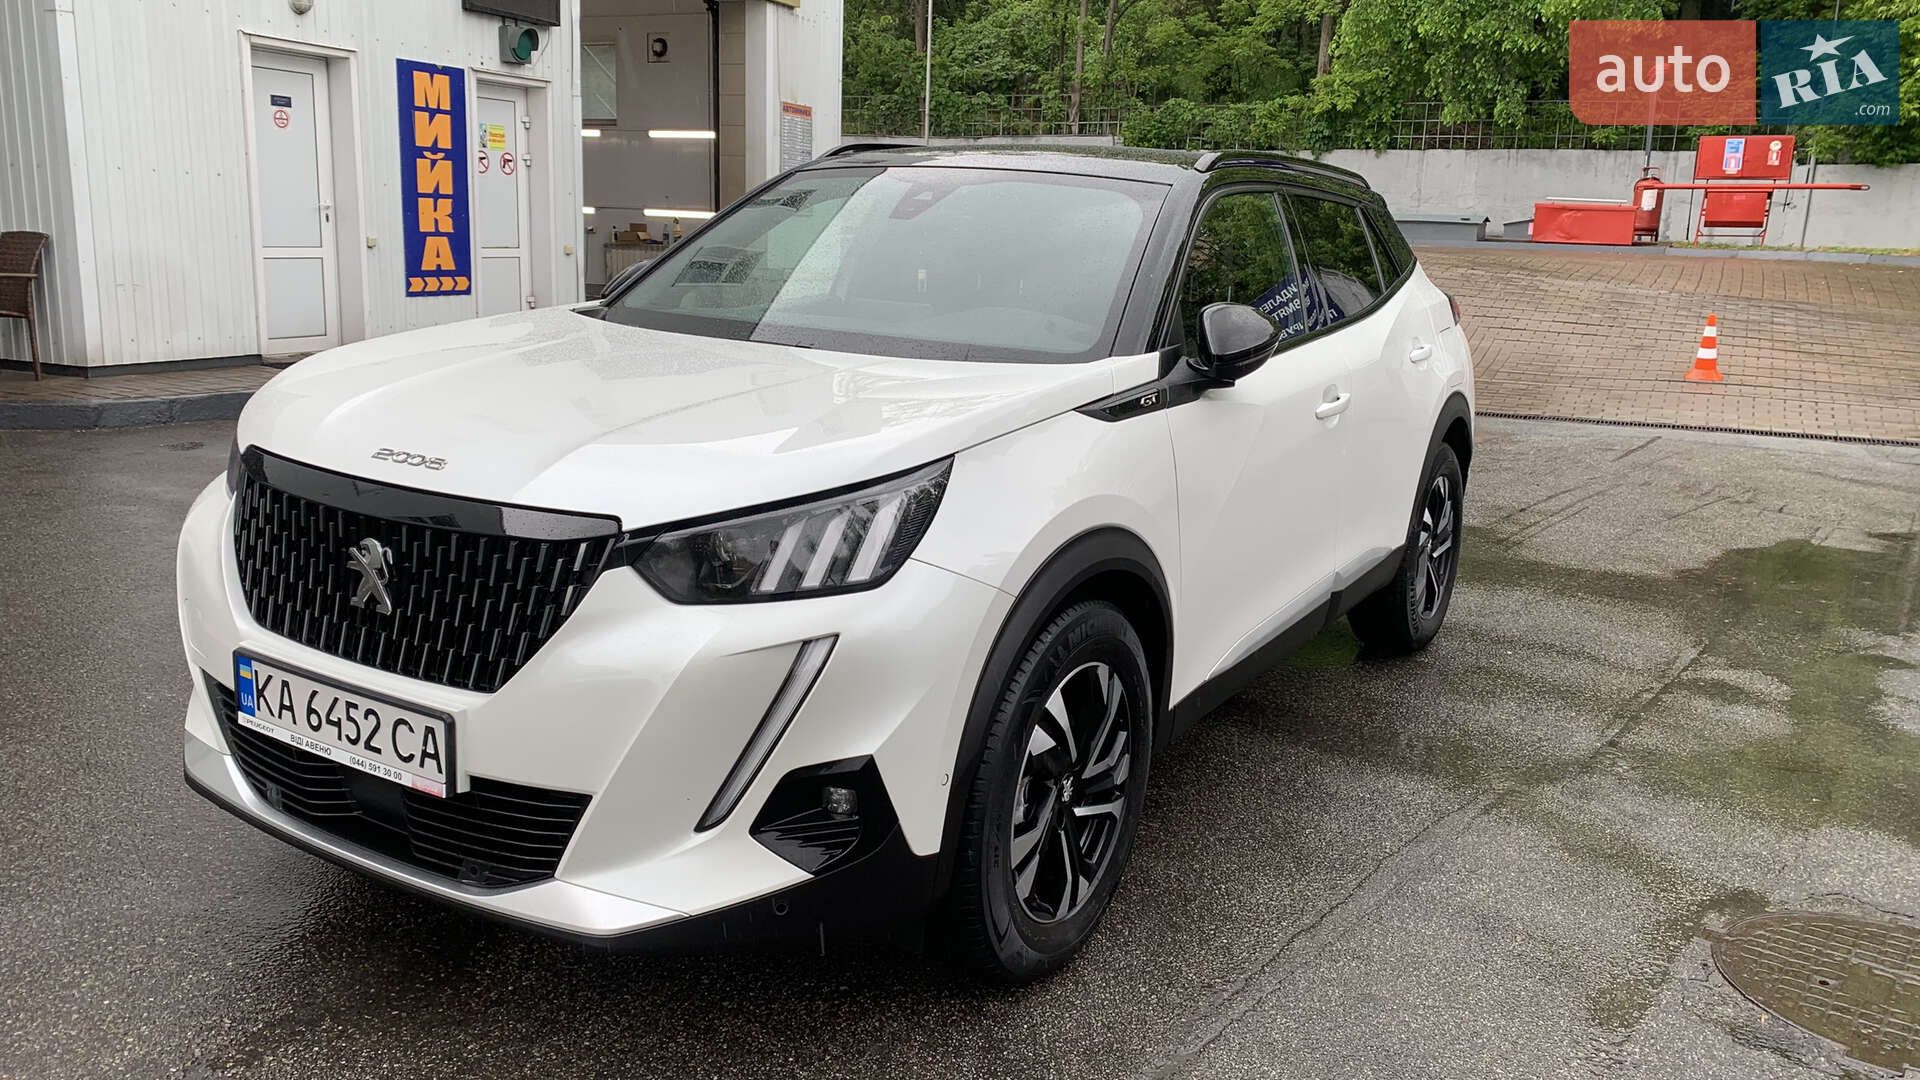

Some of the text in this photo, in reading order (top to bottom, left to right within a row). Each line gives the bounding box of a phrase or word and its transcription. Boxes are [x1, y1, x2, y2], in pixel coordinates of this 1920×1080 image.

[412, 70, 456, 271] МИЙКА
[1140, 392, 1159, 408] GT
[371, 447, 448, 471] 2008
[241, 692, 254, 709] UA
[254, 669, 443, 775] KA 6452 CA
[305, 741, 332, 757] АВЕНЮ
[349, 756, 367, 769] (044)
